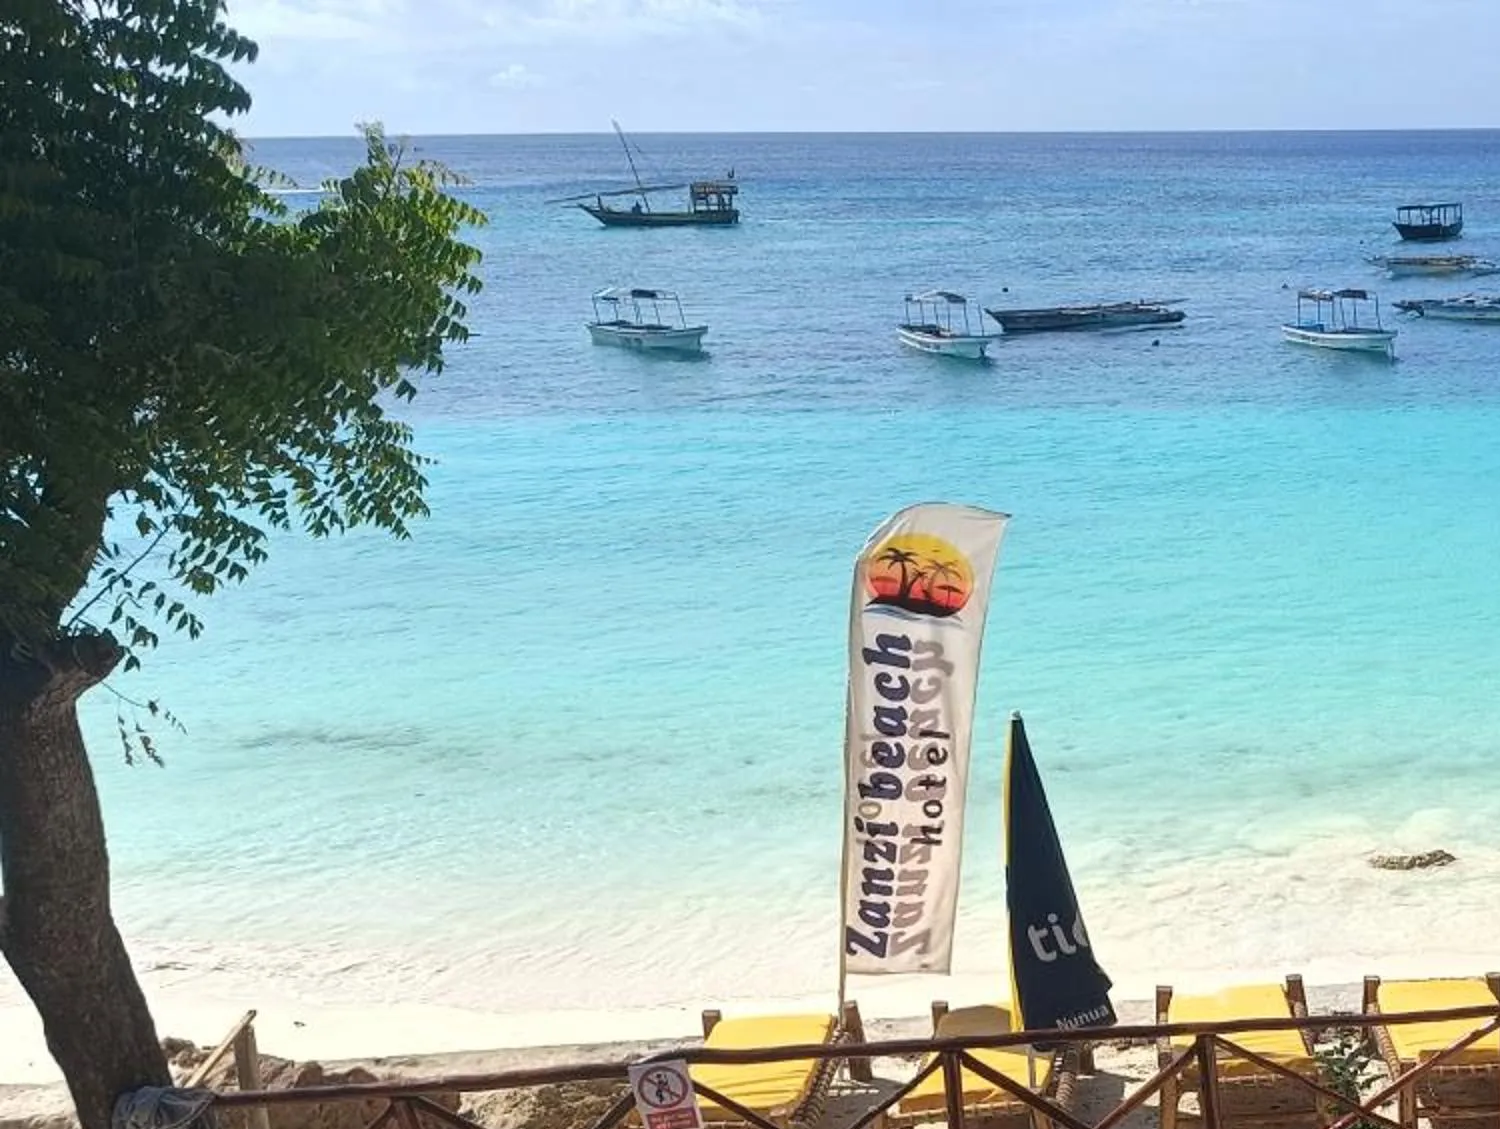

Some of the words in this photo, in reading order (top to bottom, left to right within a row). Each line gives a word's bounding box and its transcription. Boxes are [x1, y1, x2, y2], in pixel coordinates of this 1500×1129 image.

[859, 632, 912, 801] beach
[911, 730, 951, 846] hotel
[845, 819, 899, 960] Zanzi
[1055, 1004, 1109, 1032] Nunua
